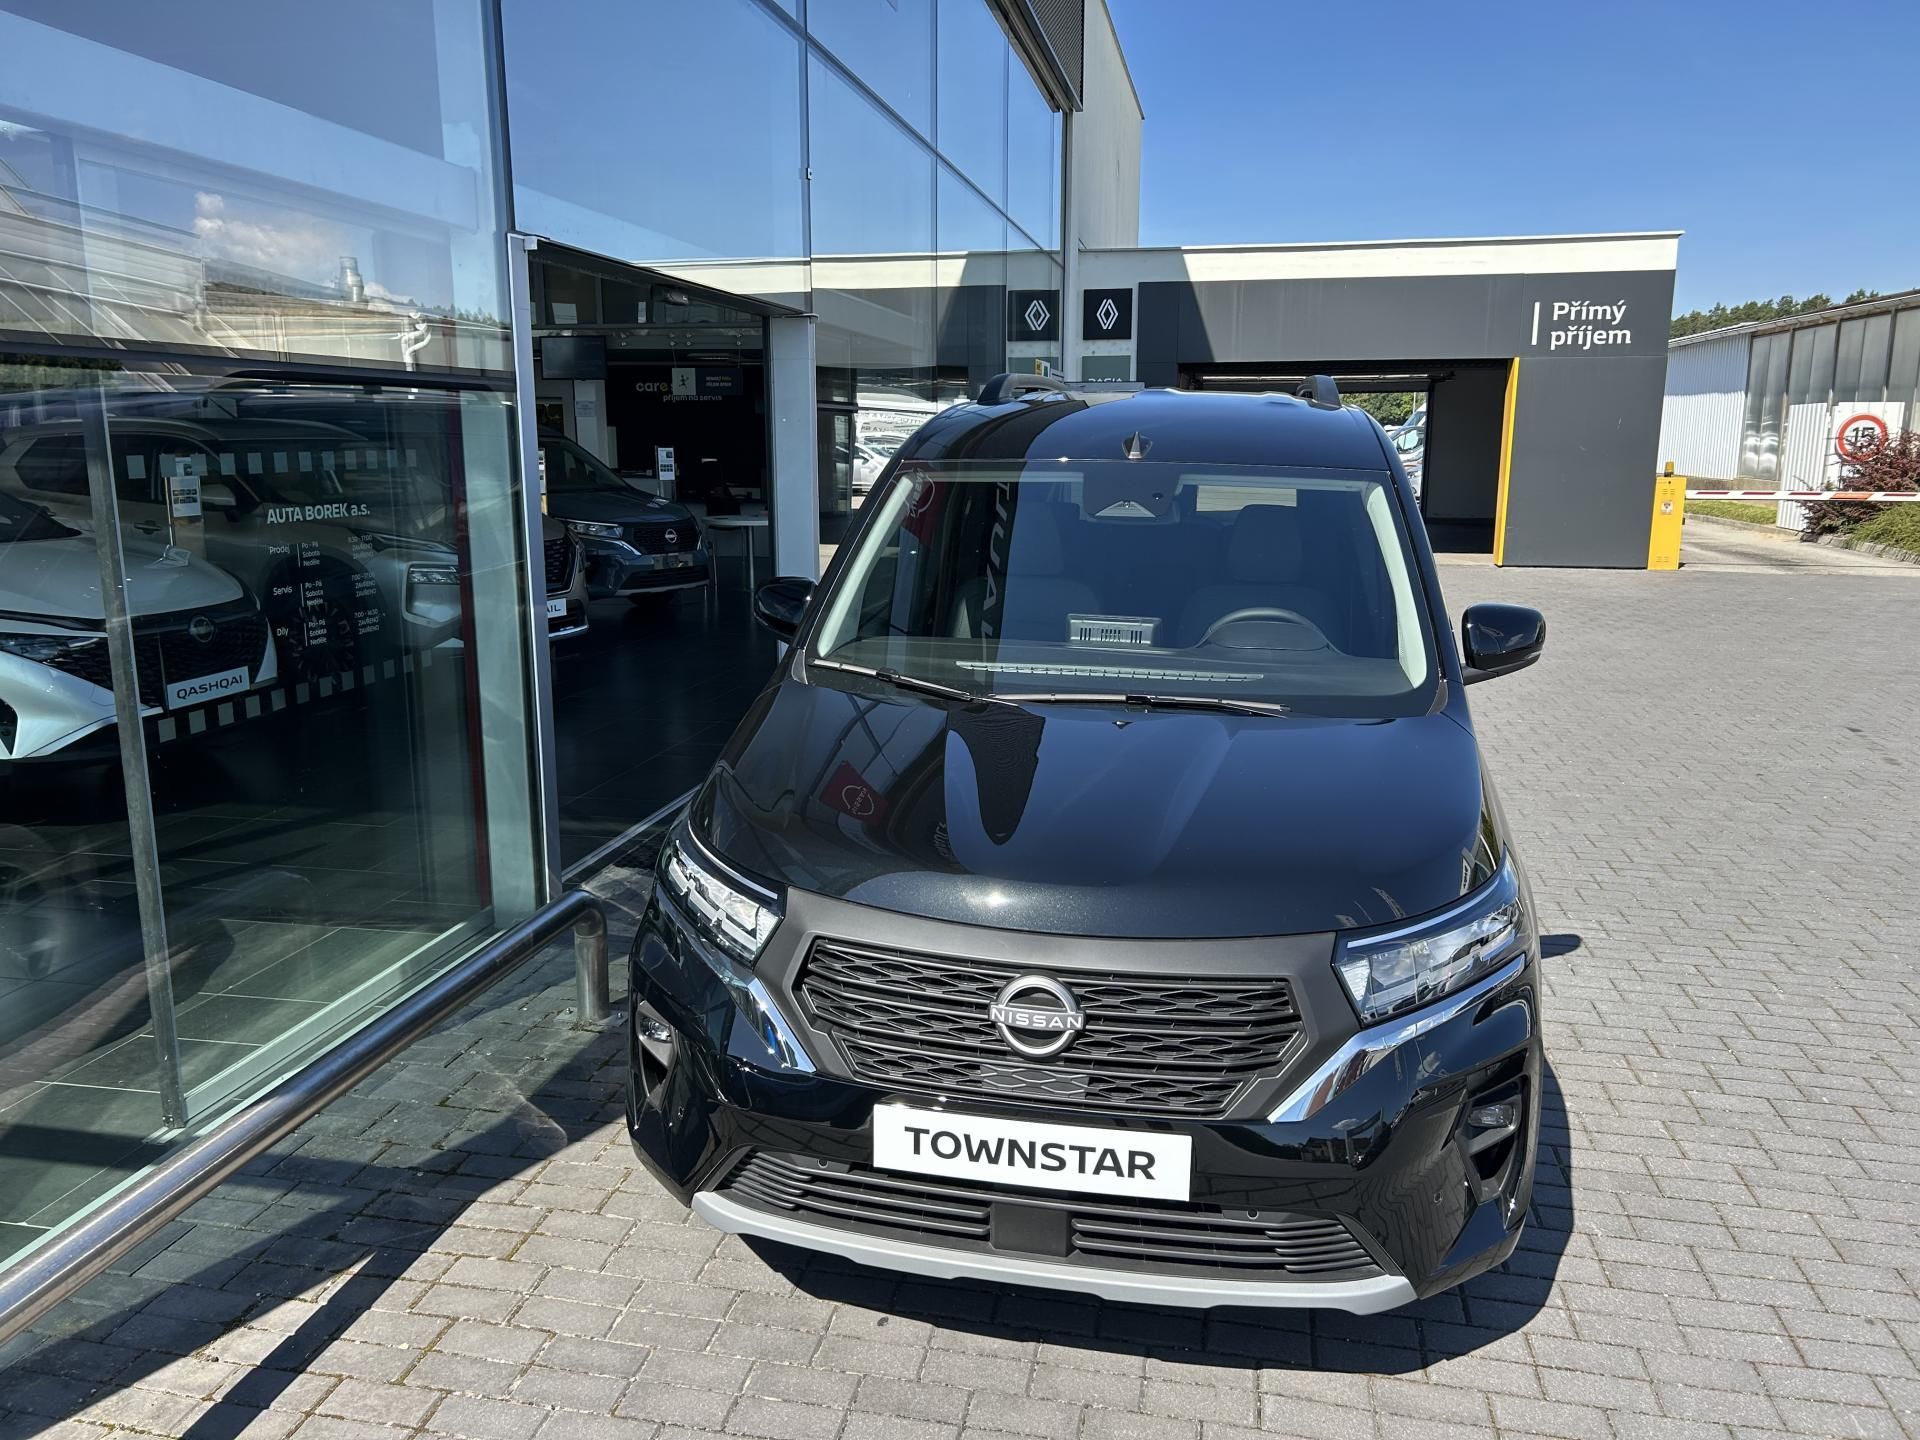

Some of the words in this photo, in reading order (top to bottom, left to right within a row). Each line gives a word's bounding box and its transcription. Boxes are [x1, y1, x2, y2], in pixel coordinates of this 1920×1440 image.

[1552, 300, 1627, 325] Přímý
[1550, 325, 1632, 351] příjem
[635, 382, 669, 392] care
[1852, 427, 1875, 445] 15
[266, 507, 303, 524] AUTA
[305, 503, 349, 520] BOREK
[351, 503, 371, 516] a.s.
[269, 544, 290, 554] Prodej
[273, 585, 293, 596] Servis
[176, 675, 243, 700] QASHQAI
[991, 1007, 1083, 1029] NISSAN
[904, 1126, 1156, 1180] TOWNSTAR
